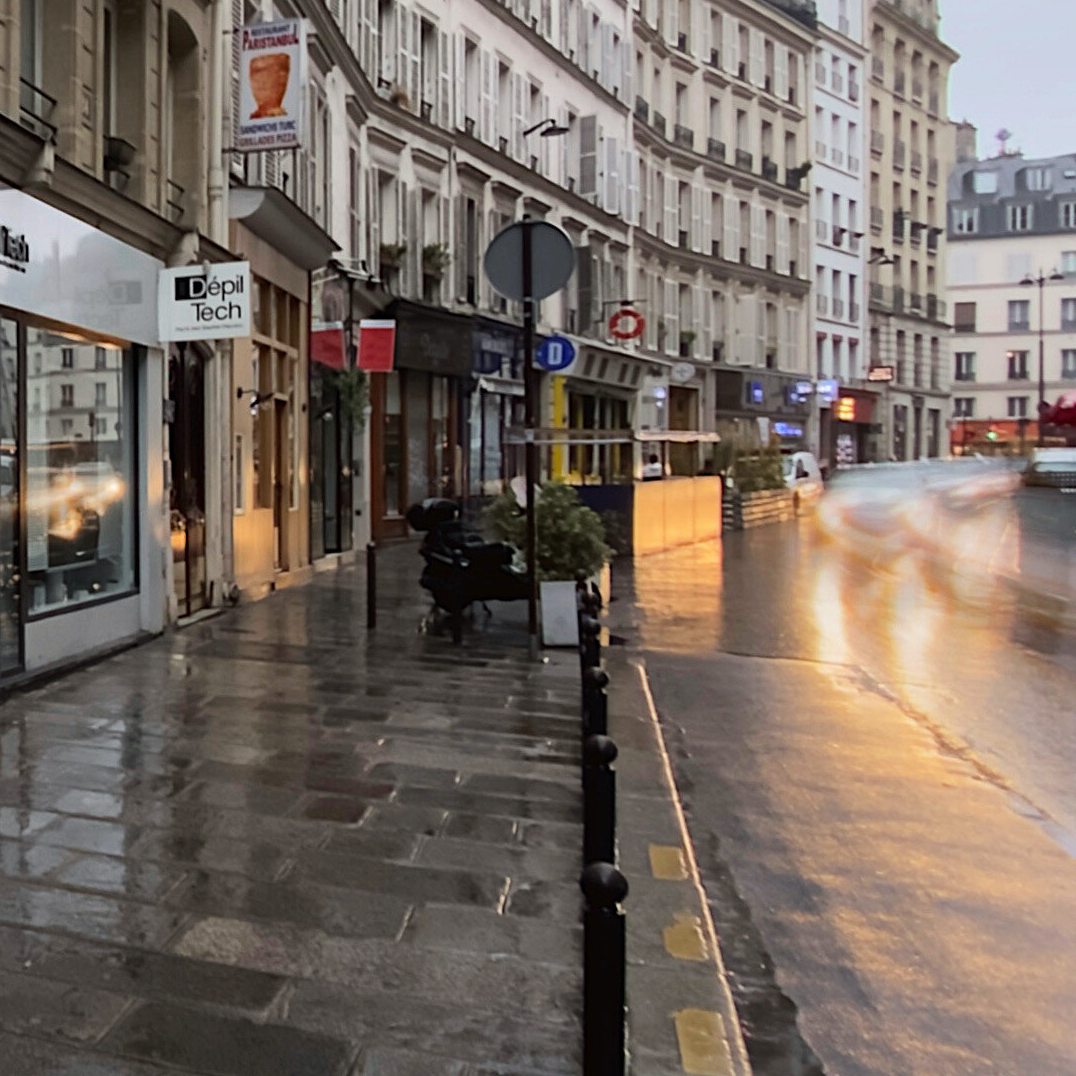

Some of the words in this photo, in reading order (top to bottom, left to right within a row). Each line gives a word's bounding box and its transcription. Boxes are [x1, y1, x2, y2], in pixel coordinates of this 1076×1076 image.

[243, 24, 300, 51] PARISTANBUL
[189, 275, 244, 301] Dépil
[190, 301, 241, 321] Tech
